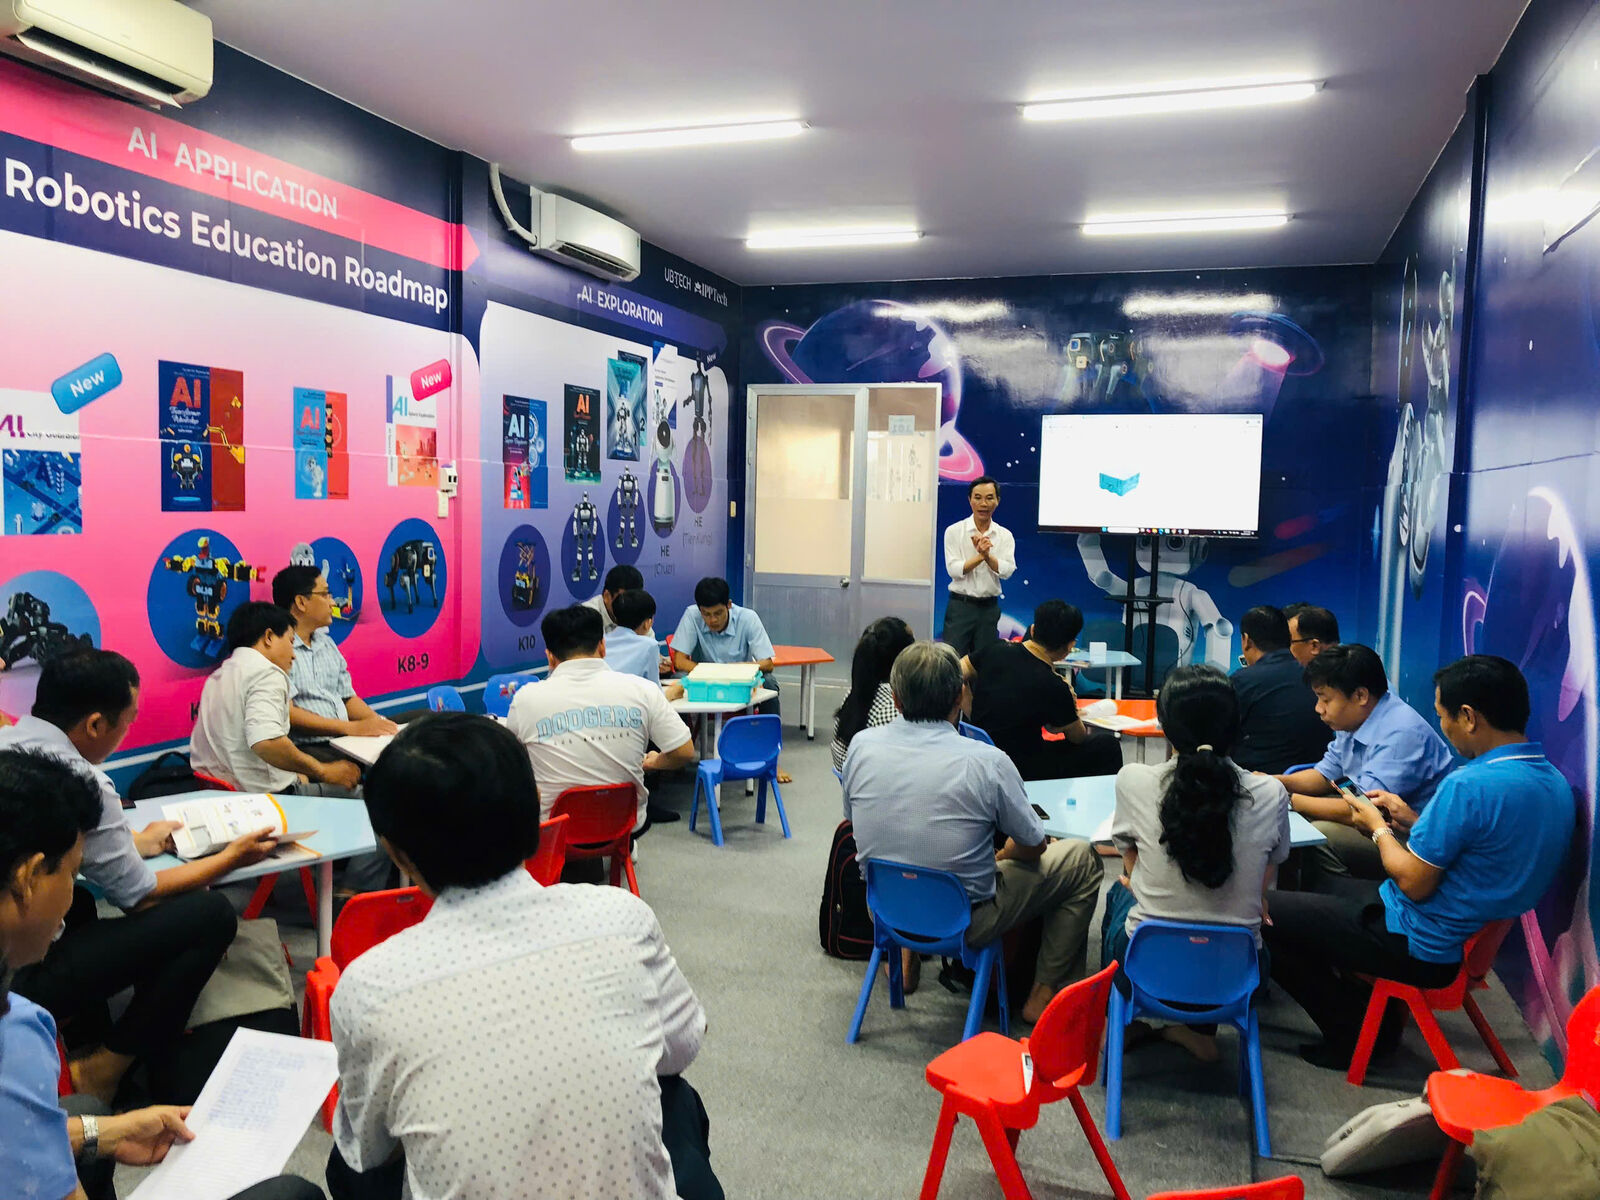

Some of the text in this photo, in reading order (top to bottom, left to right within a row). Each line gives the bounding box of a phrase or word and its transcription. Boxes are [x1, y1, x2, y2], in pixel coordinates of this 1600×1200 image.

[128, 126, 339, 219] AI APPLICATION
[5, 157, 448, 314] Robotics Education Roadmap
[664, 267, 692, 291] UBTECH
[581, 285, 663, 327] AI EXPLORATION
[69, 370, 105, 398] New
[420, 370, 442, 390] New
[170, 376, 201, 409] AI
[577, 393, 590, 414] AI
[300, 406, 320, 430] AI
[392, 395, 408, 417] AI
[508, 413, 525, 438] AI
[660, 545, 670, 557] HE
[518, 637, 536, 652] K10
[397, 653, 429, 675] K8-9
[536, 704, 643, 741] DODGERS
